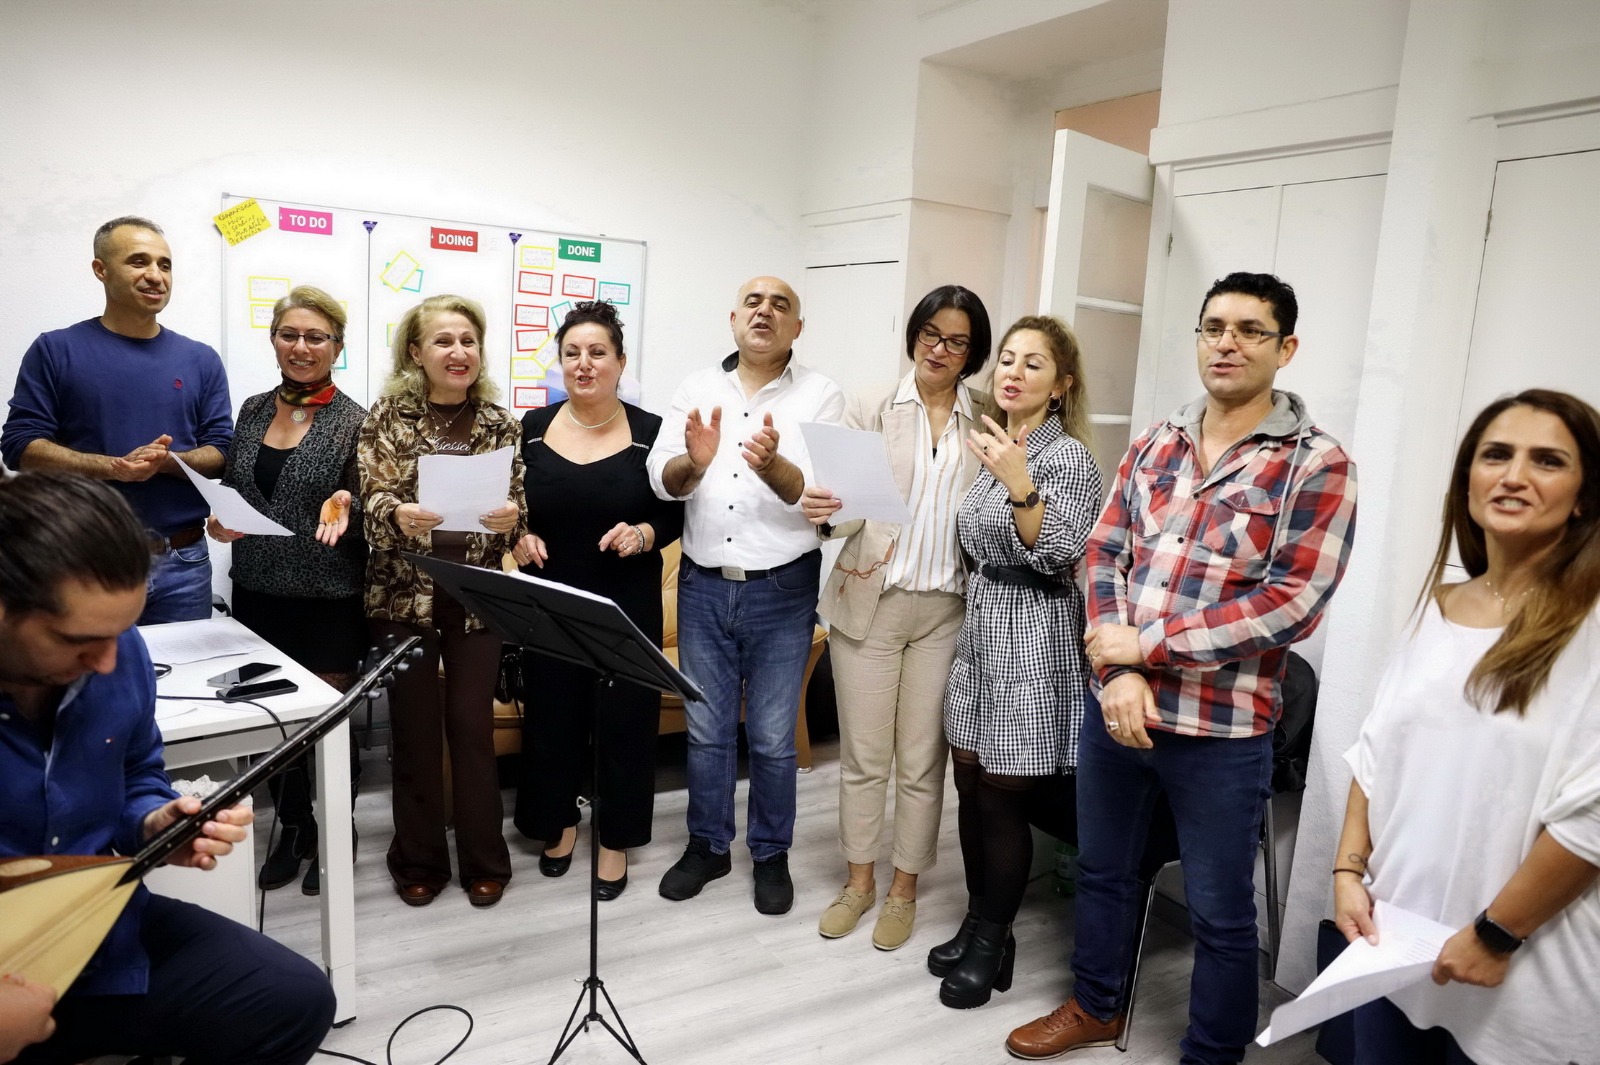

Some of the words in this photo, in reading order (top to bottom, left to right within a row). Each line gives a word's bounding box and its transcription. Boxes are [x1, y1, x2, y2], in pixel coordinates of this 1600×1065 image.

[288, 214, 306, 227] TO
[309, 216, 327, 229] DO
[438, 233, 474, 247] DOING
[567, 245, 596, 257] DONE
